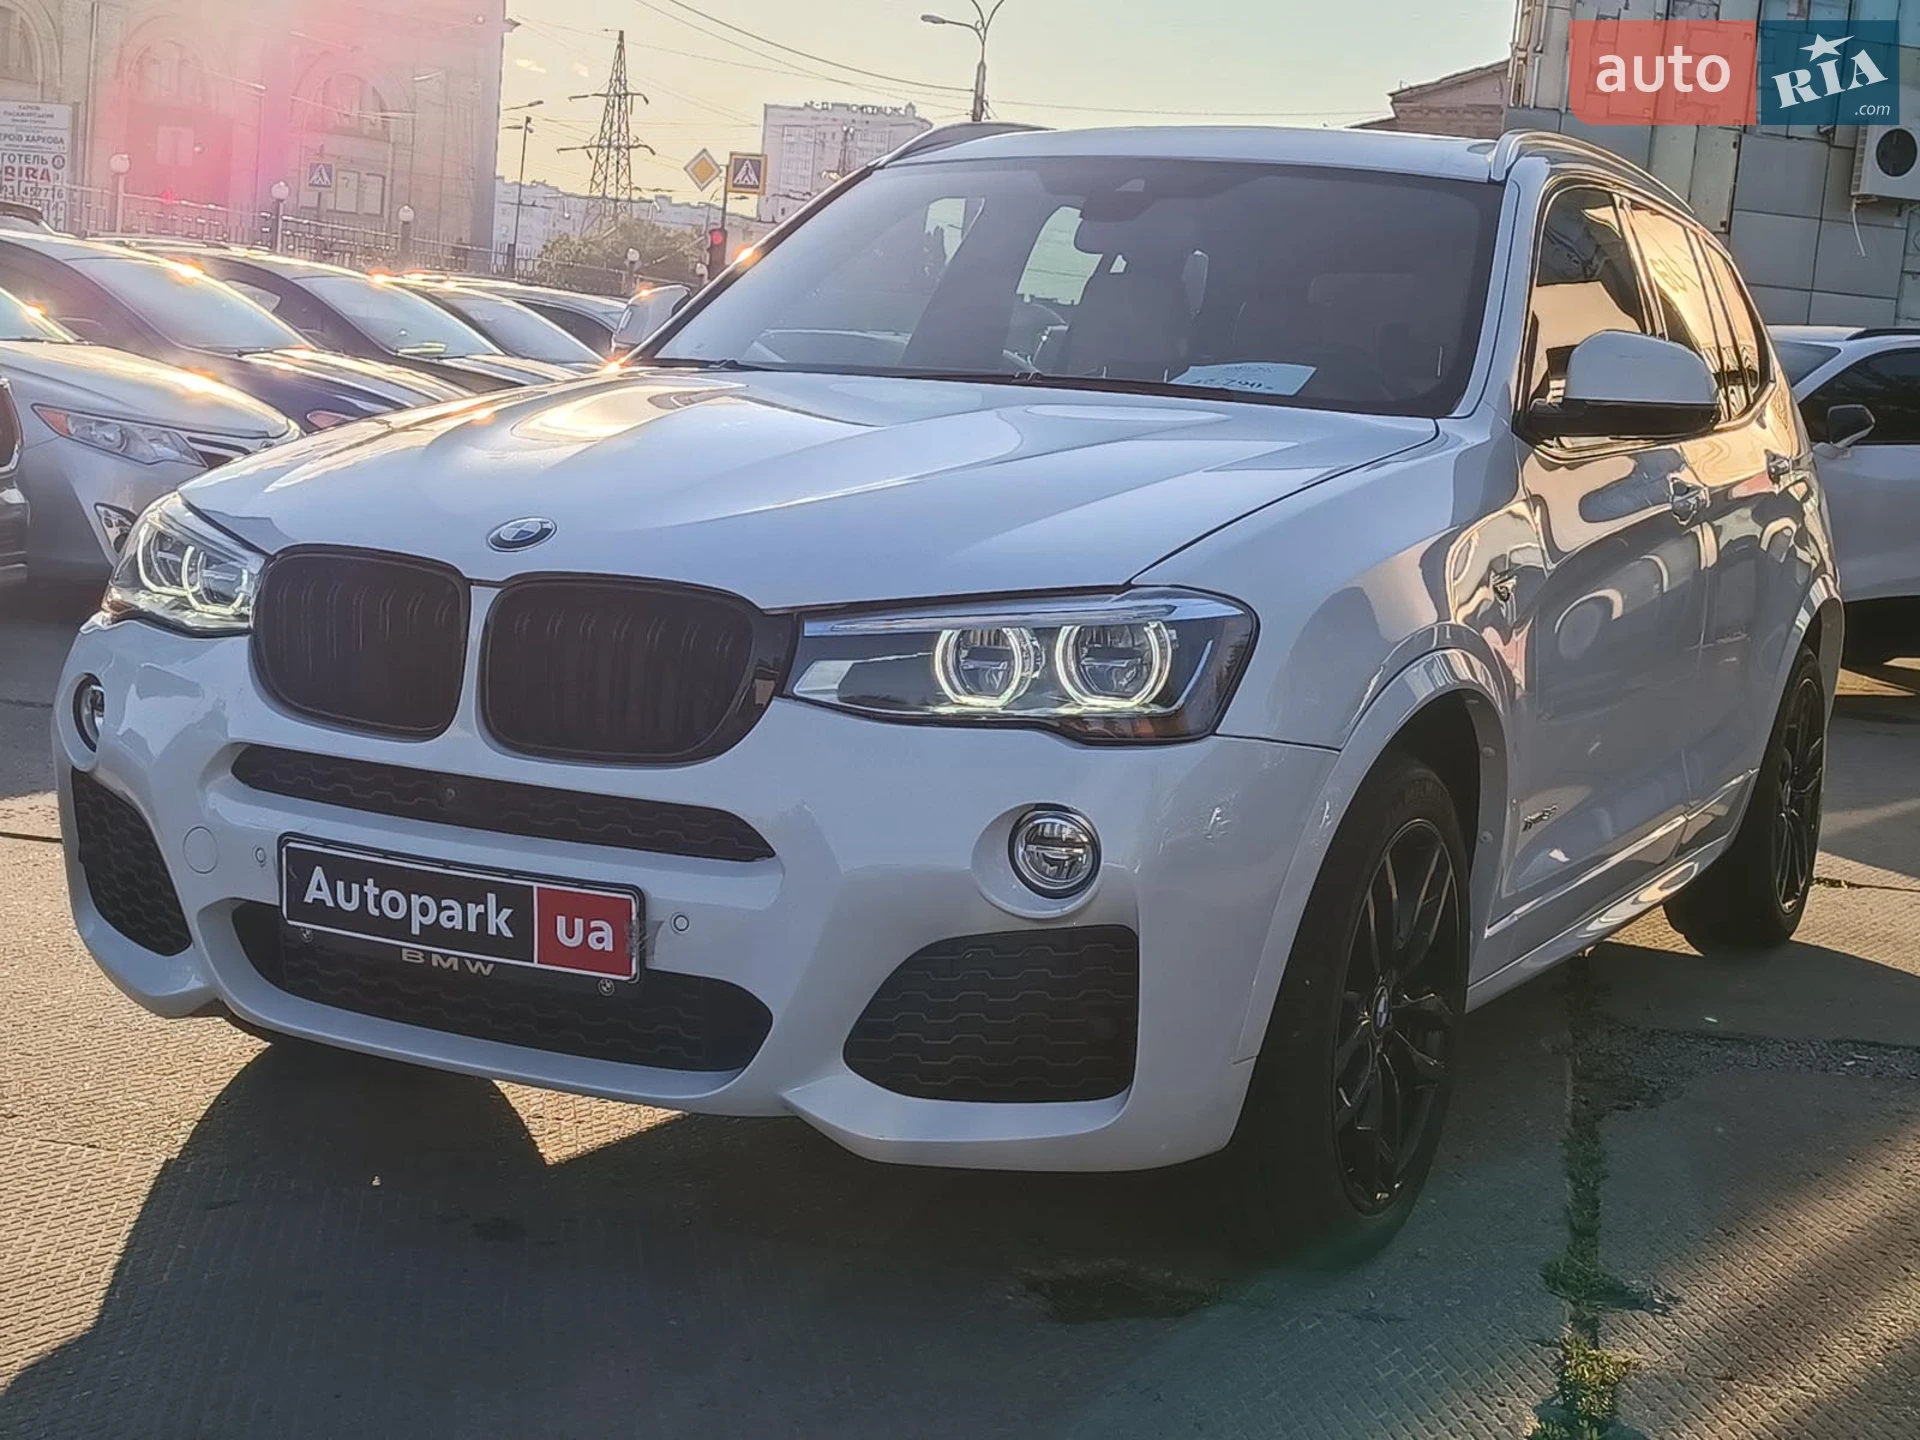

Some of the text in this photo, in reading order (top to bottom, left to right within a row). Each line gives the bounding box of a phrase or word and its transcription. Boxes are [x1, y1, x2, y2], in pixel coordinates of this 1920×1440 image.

[1, 152, 49, 165] ГОТЕЛЬ
[303, 865, 614, 952] Autopark ua
[401, 947, 495, 976] BMW
